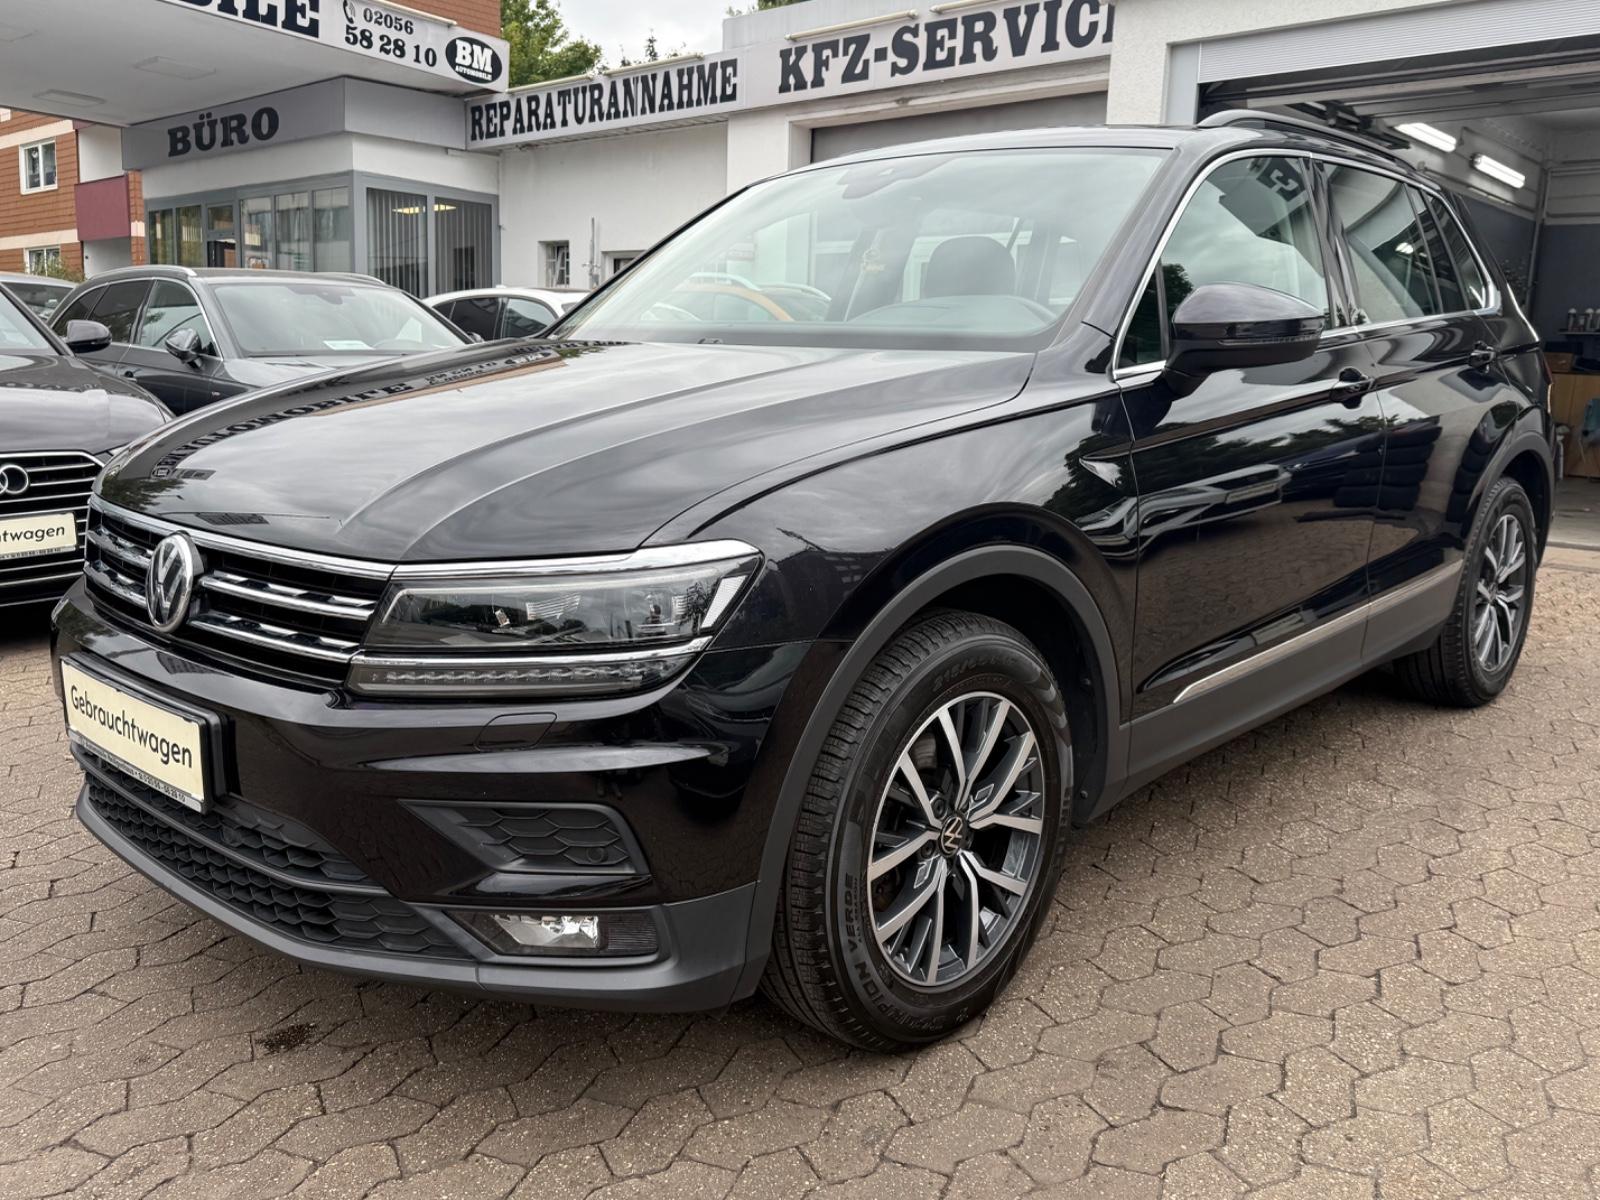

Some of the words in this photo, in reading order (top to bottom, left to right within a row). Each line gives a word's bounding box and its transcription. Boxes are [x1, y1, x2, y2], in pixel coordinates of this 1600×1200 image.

[178, 0, 320, 39] LE
[363, 7, 414, 35] 02056
[345, 24, 373, 49] 58
[379, 34, 406, 58] 28
[413, 44, 437, 67] 10
[455, 39, 493, 73] BM
[455, 65, 492, 81] AUTOMOBILE
[470, 58, 738, 141] REPARATURANNAHME
[167, 106, 280, 157] BÜRO
[70, 685, 193, 768] Gebrauchtwagen
[845, 872, 859, 953] VERDE
